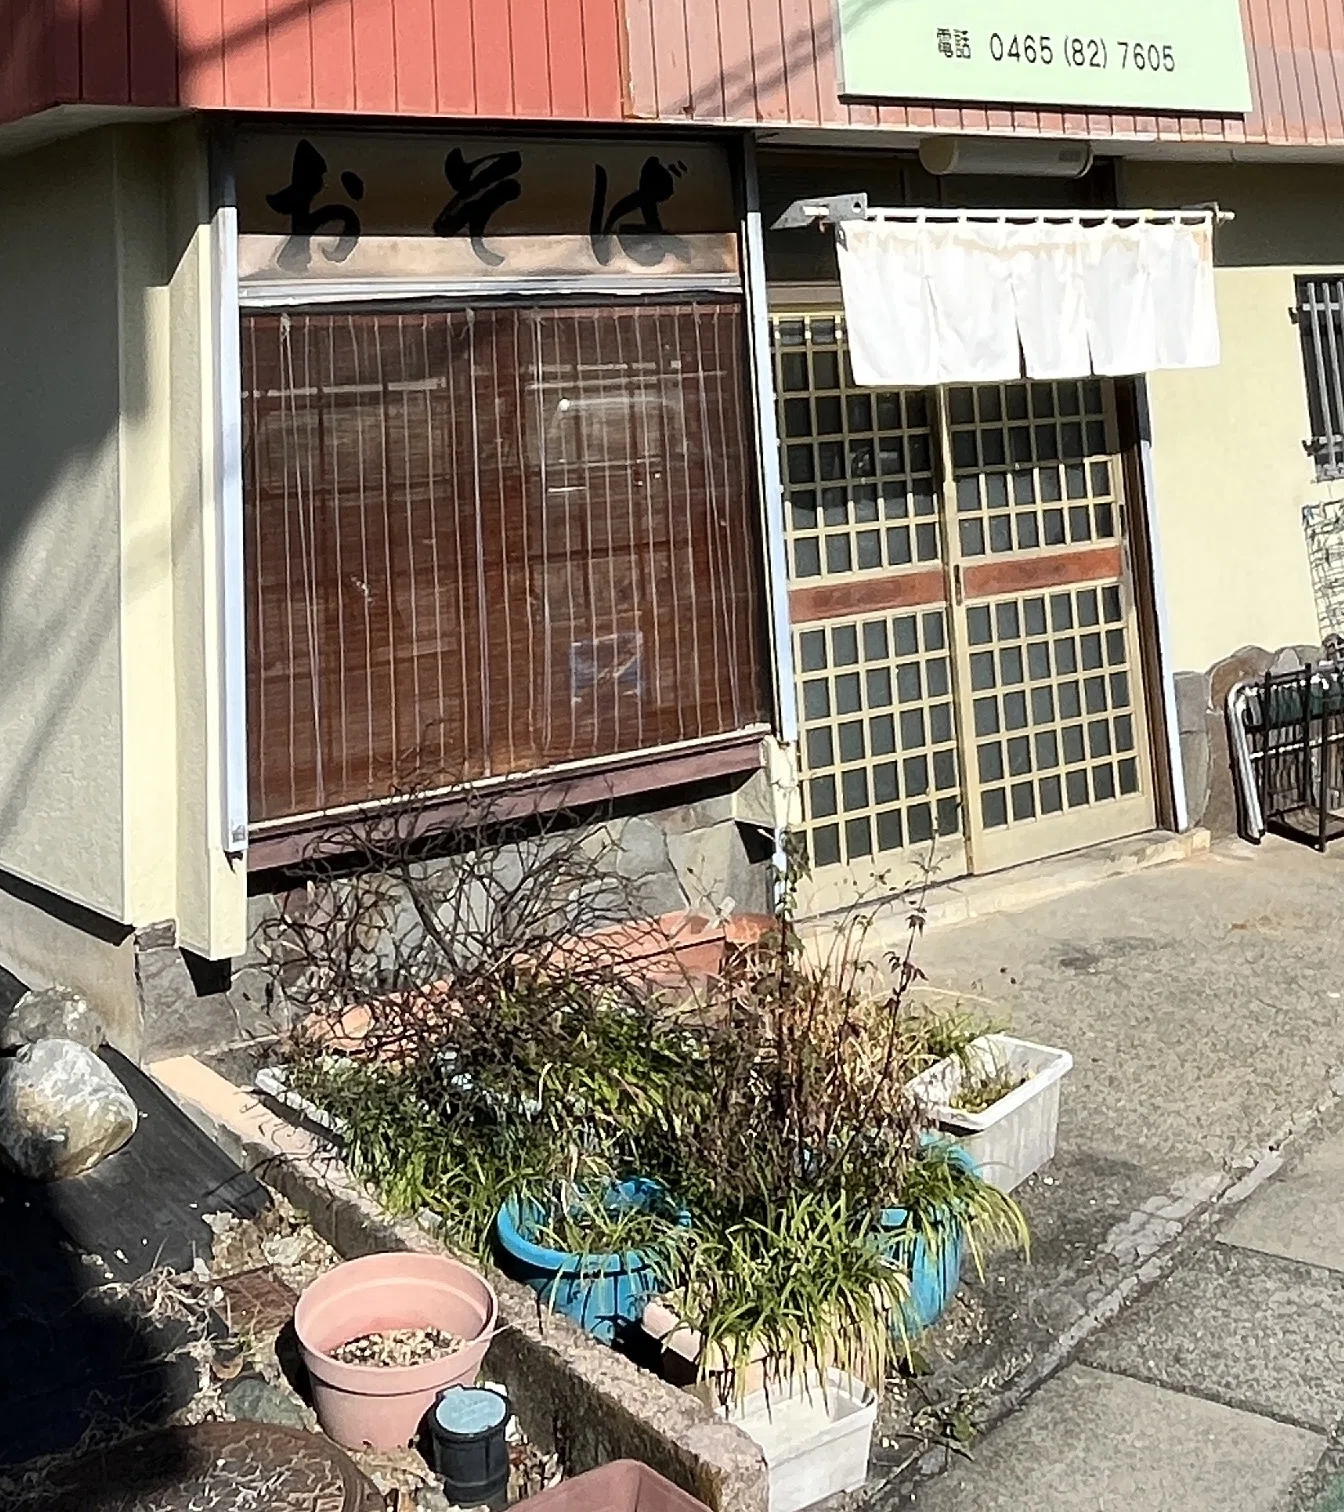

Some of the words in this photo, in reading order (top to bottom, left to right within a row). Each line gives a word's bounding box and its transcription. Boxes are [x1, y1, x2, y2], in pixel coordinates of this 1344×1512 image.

[936, 27, 971, 59] 電話
[989, 32, 1053, 65] 0465
[1064, 34, 1108, 70] (82)
[1117, 40, 1175, 72] 7605
[265, 139, 692, 272] おそば
